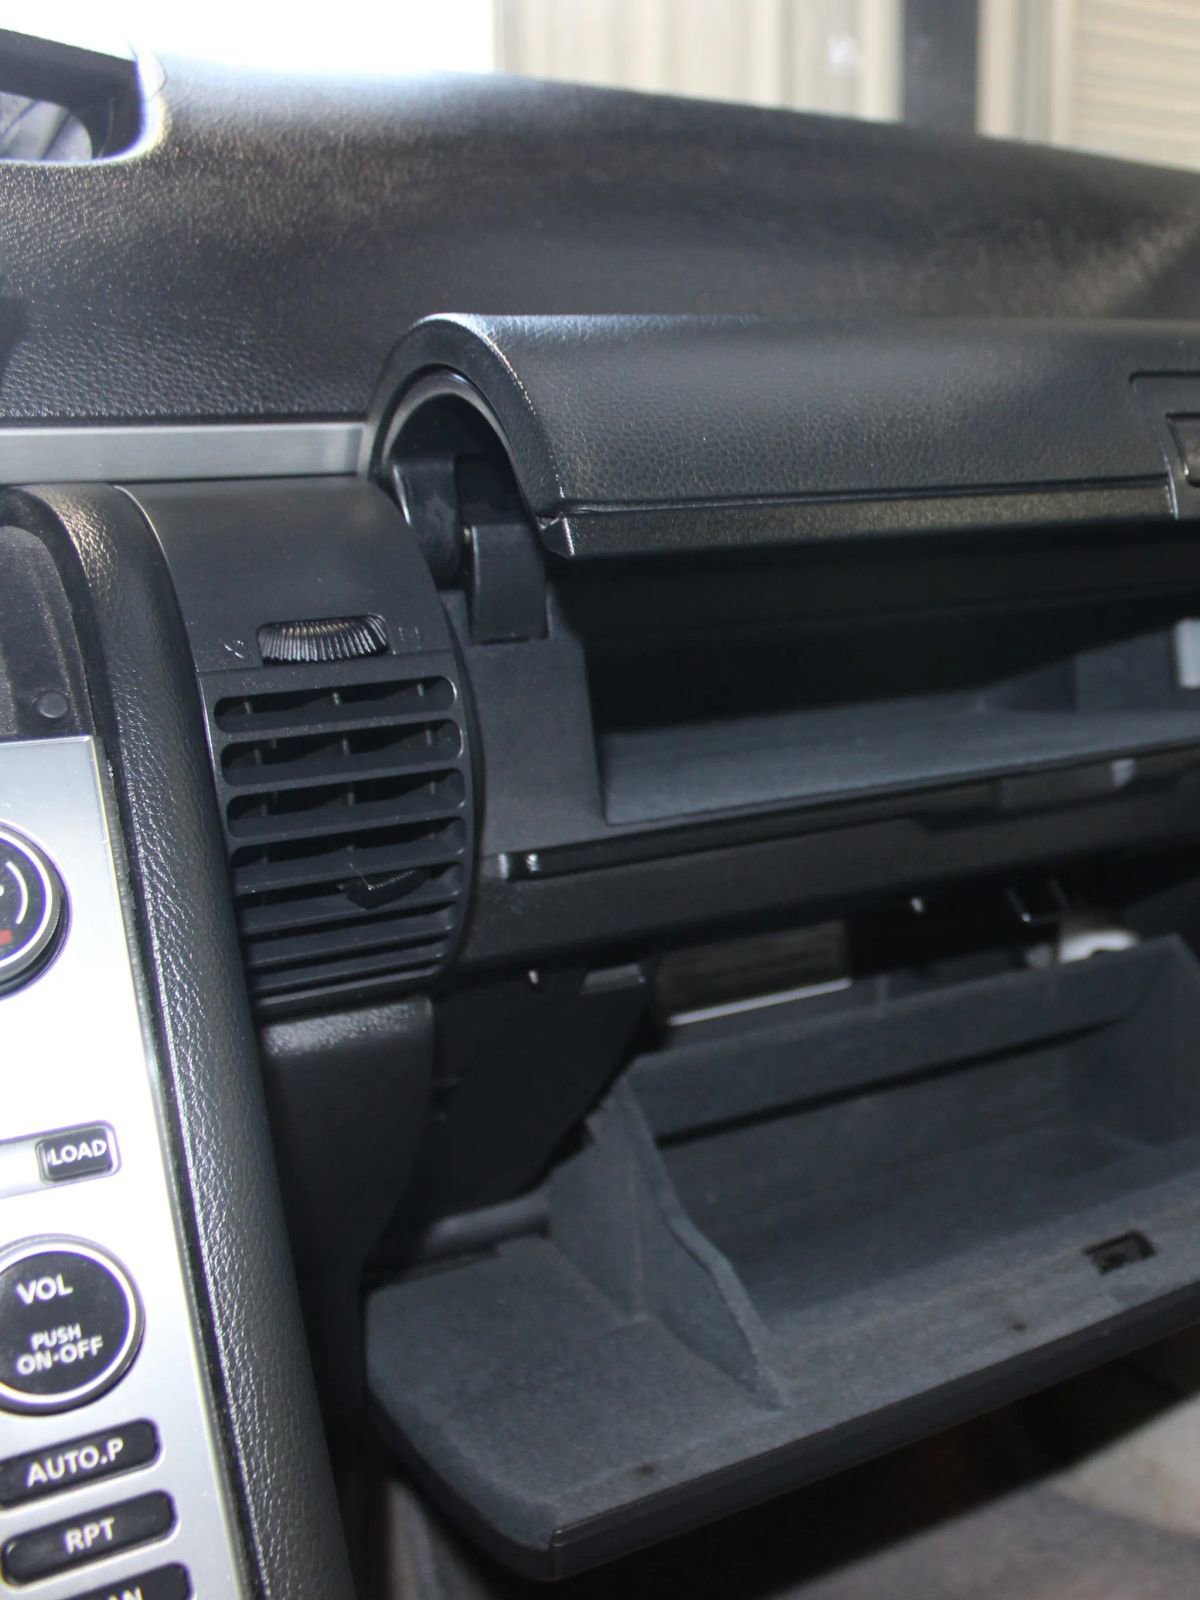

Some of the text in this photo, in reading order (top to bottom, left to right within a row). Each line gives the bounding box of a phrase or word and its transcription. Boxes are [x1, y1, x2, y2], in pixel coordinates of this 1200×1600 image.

[49, 1139, 107, 1167] LOAD
[16, 1273, 74, 1305] VOL
[30, 1322, 82, 1351] PUSH
[26, 1437, 124, 1488] AUTO.P
[65, 1516, 115, 1554] RPT
